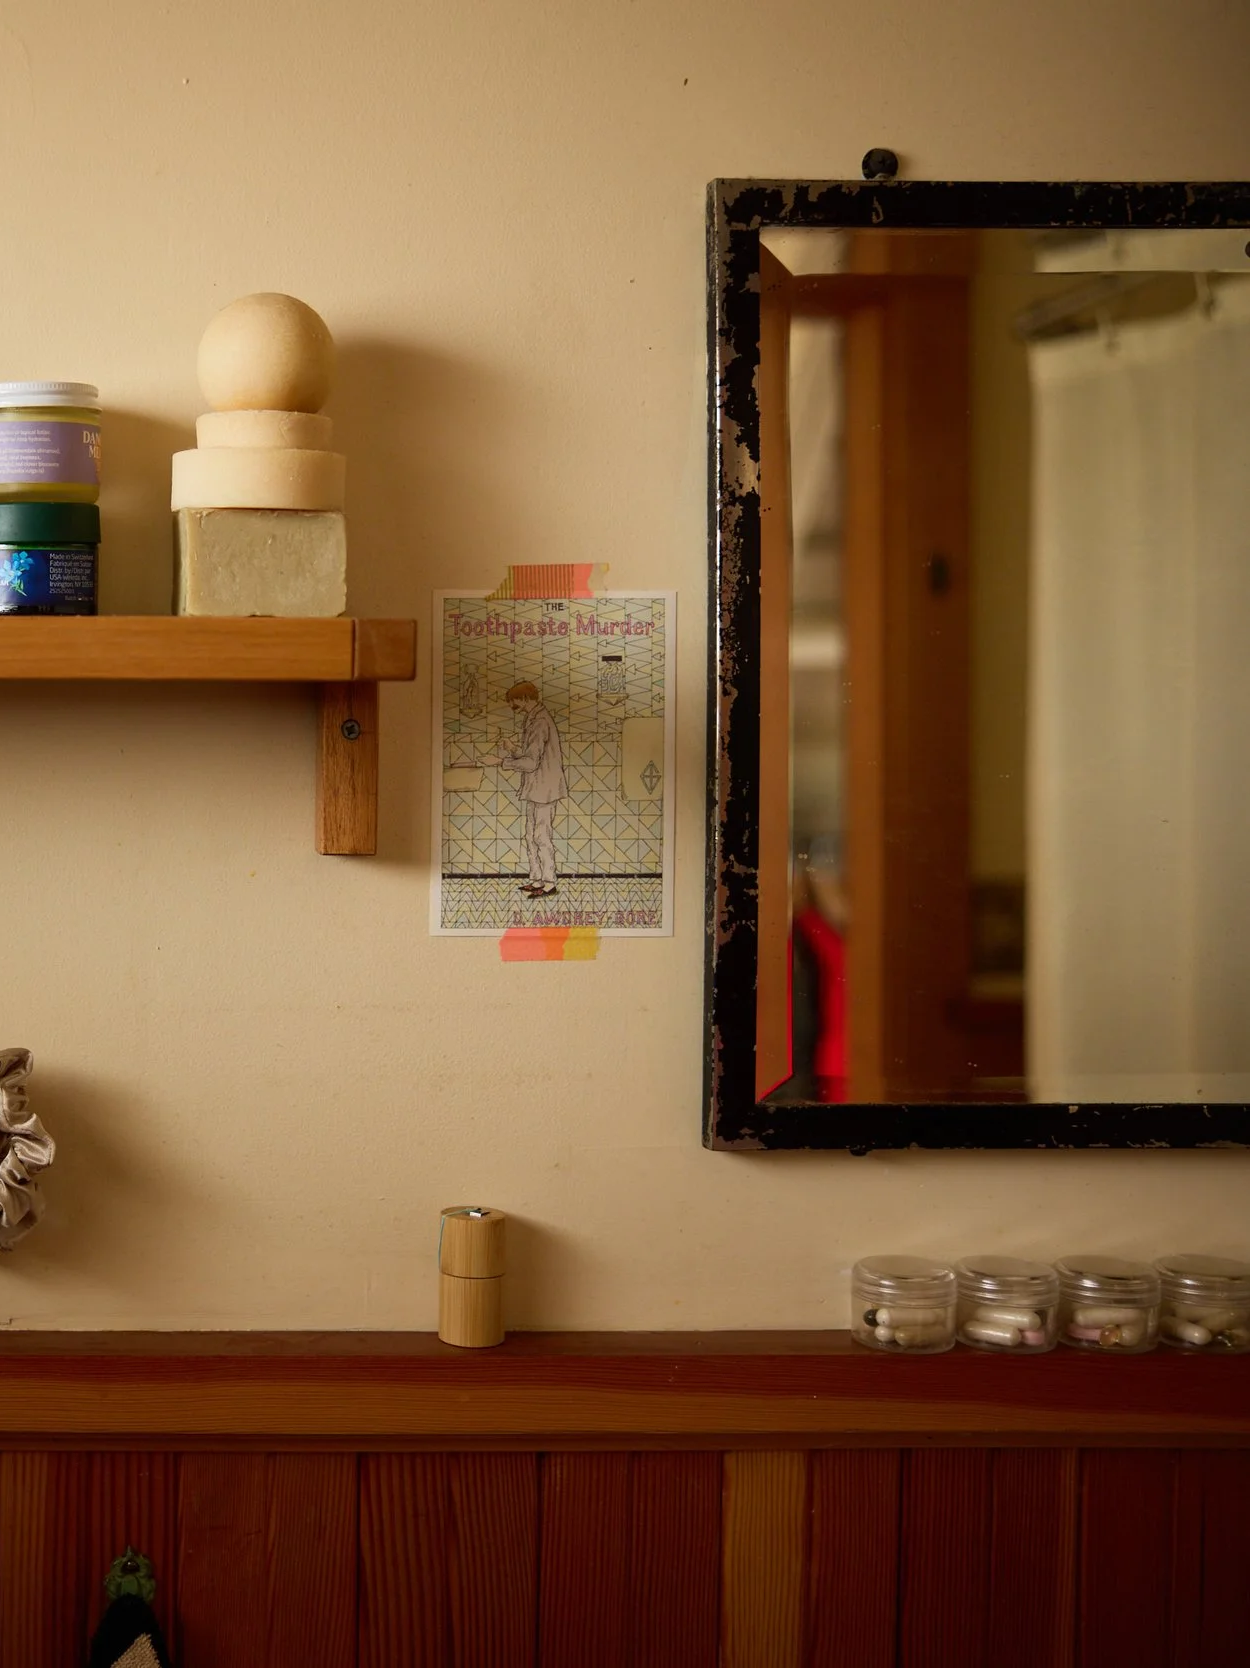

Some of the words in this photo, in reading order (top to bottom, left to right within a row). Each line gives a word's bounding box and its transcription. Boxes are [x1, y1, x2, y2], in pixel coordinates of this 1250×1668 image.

[545, 602, 565, 612] THE
[449, 613, 570, 644] Toothpaste
[575, 613, 655, 637] Murder
